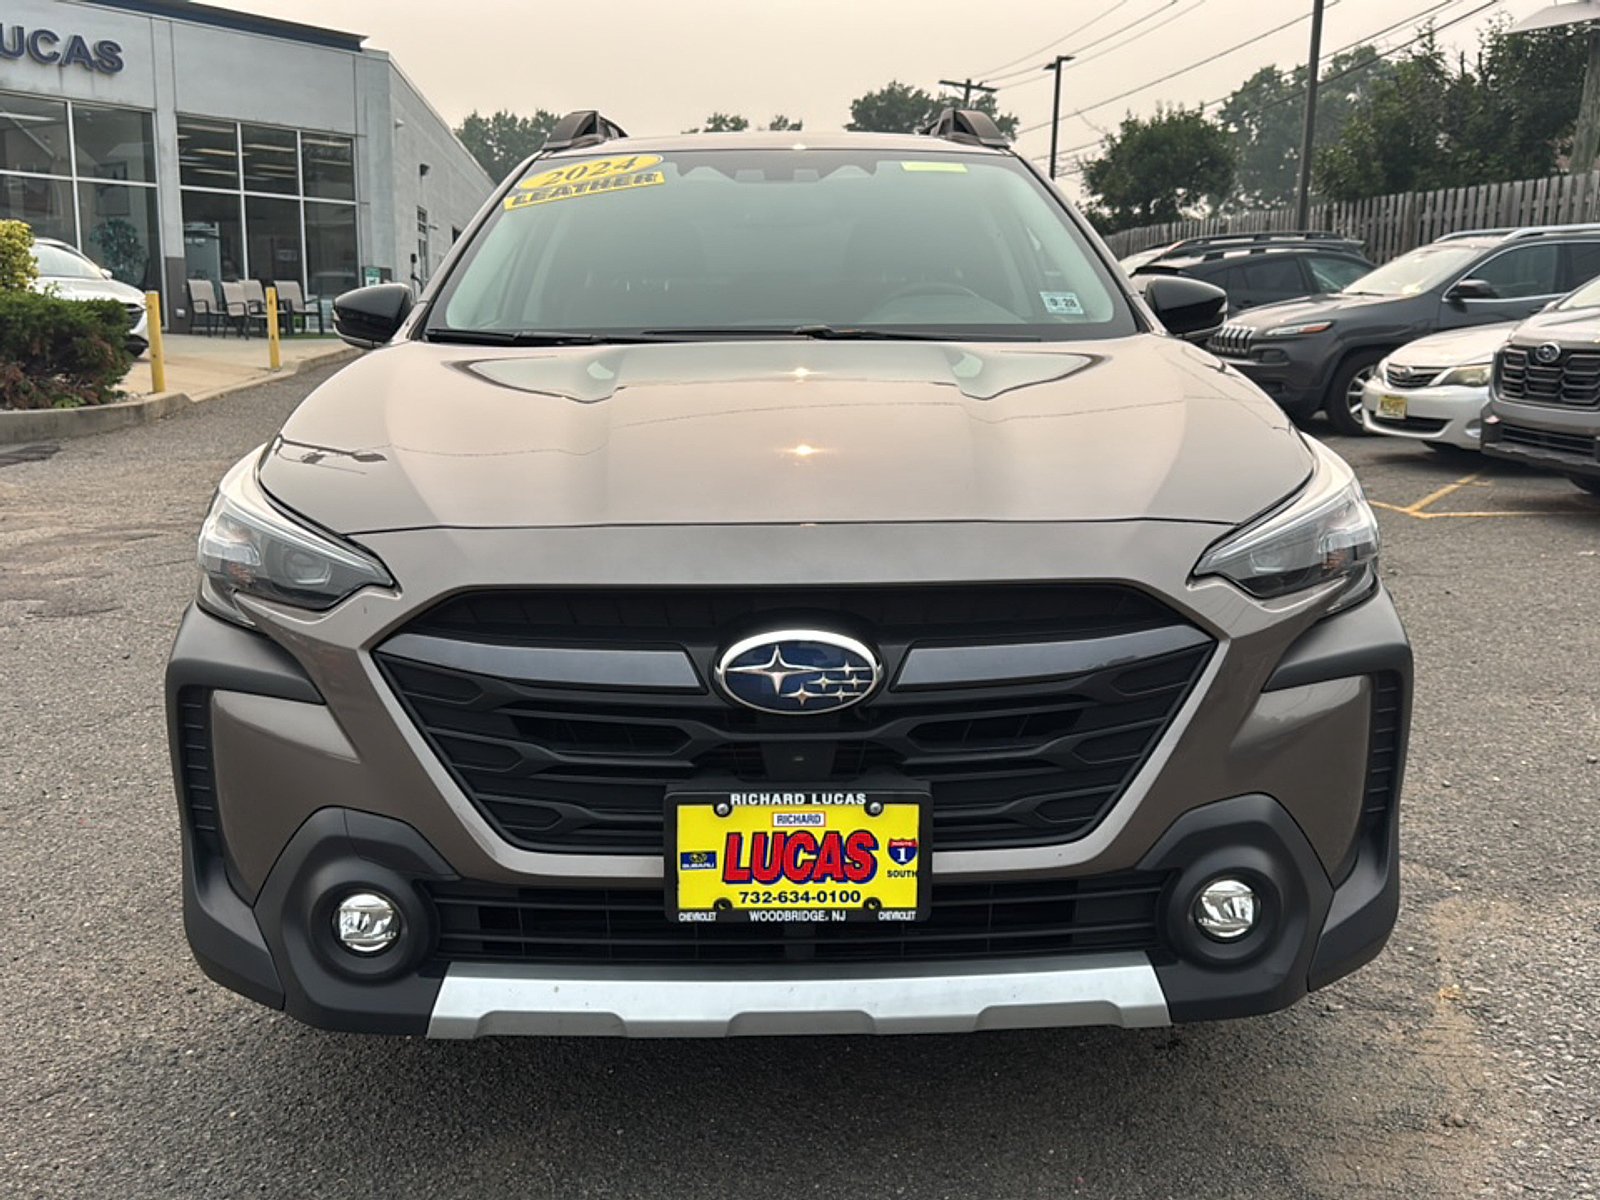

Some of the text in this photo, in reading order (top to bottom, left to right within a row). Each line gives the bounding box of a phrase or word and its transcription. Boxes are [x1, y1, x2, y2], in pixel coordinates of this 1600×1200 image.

[541, 156, 639, 186] 2024
[511, 173, 658, 206] LEATHER
[730, 793, 866, 805] RICHARD LUCAS
[776, 814, 821, 825] RICHARD
[722, 829, 879, 884] LUCAS
[897, 847, 907, 862] 1
[887, 870, 917, 878] SOUTH
[739, 890, 861, 904] 732-634-0100
[832, 910, 846, 921] NJ
